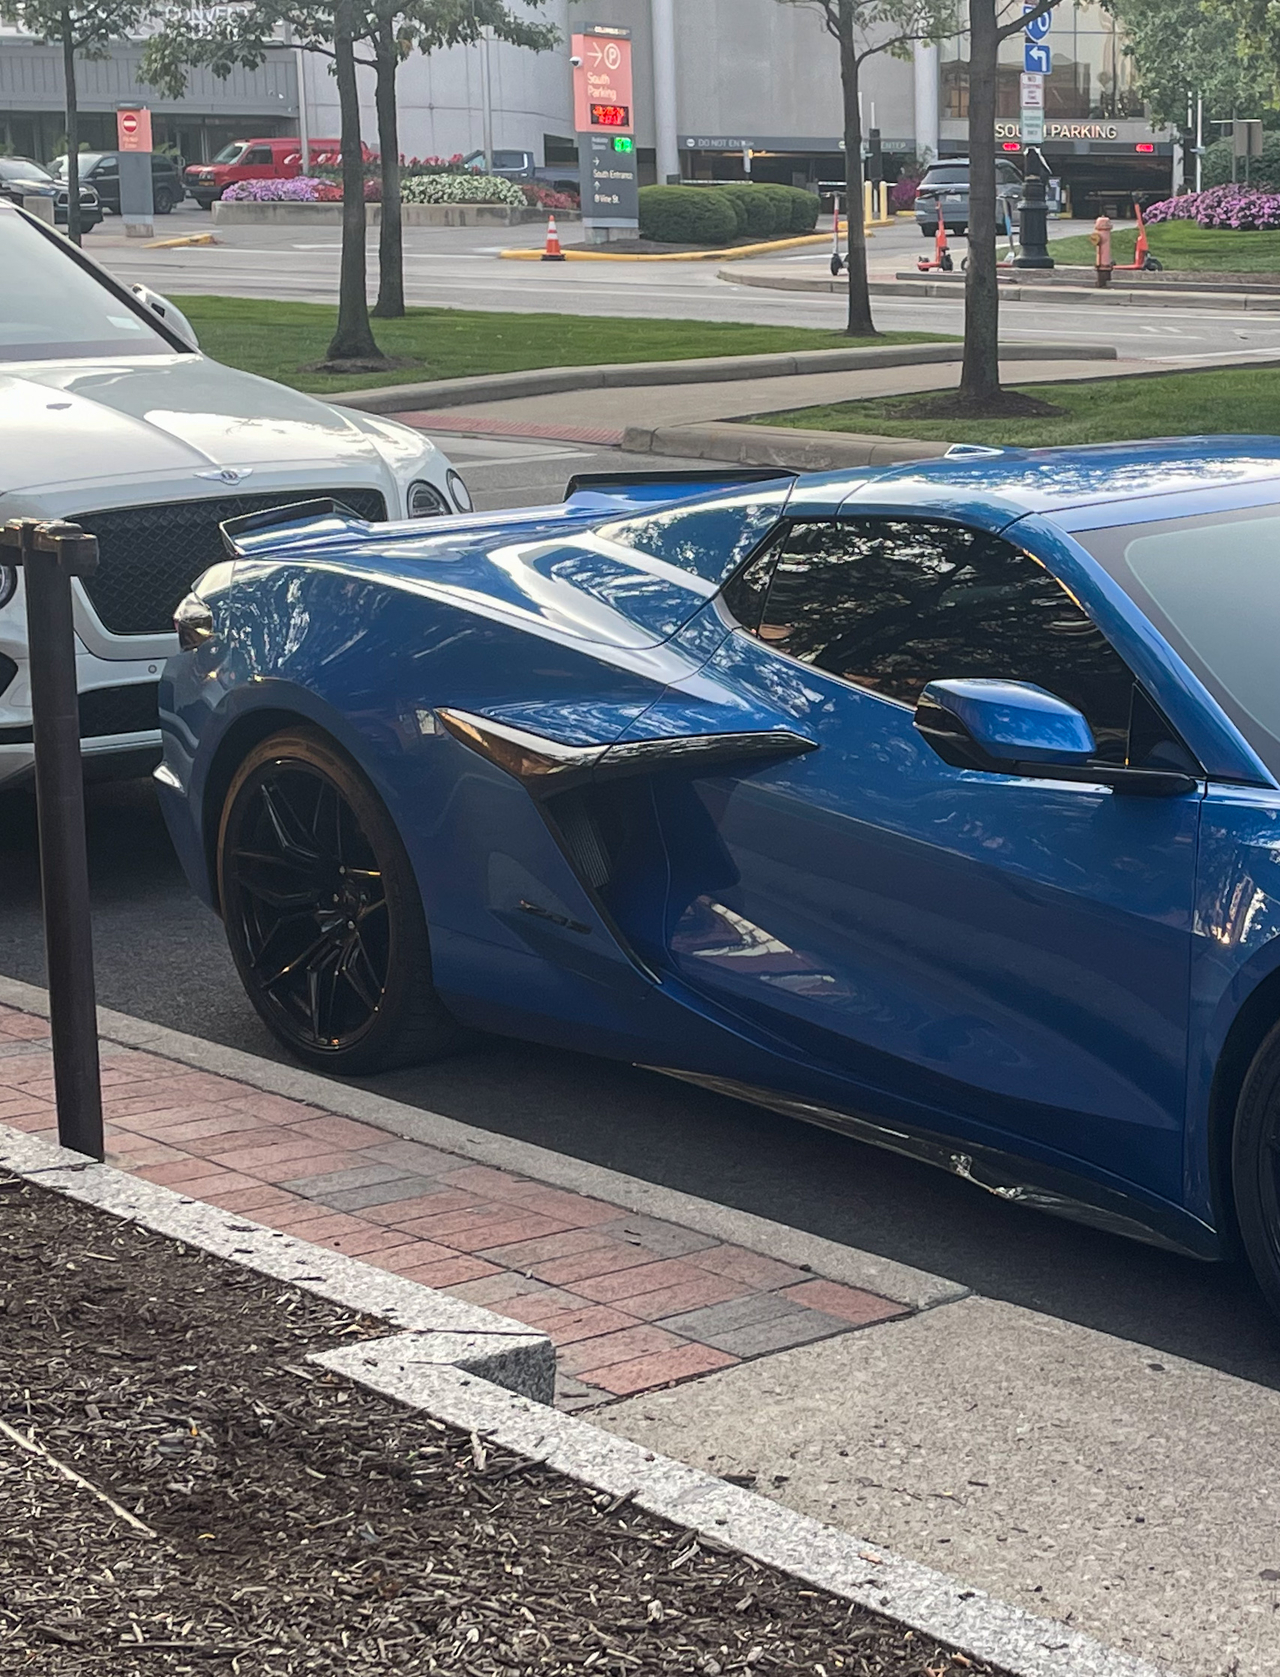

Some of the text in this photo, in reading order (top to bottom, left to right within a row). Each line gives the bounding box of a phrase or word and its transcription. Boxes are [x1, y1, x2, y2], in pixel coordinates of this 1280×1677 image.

[587, 71, 610, 85] South
[587, 84, 617, 102] Parking
[1051, 124, 1117, 139] PARKING
[593, 169, 609, 179] South
